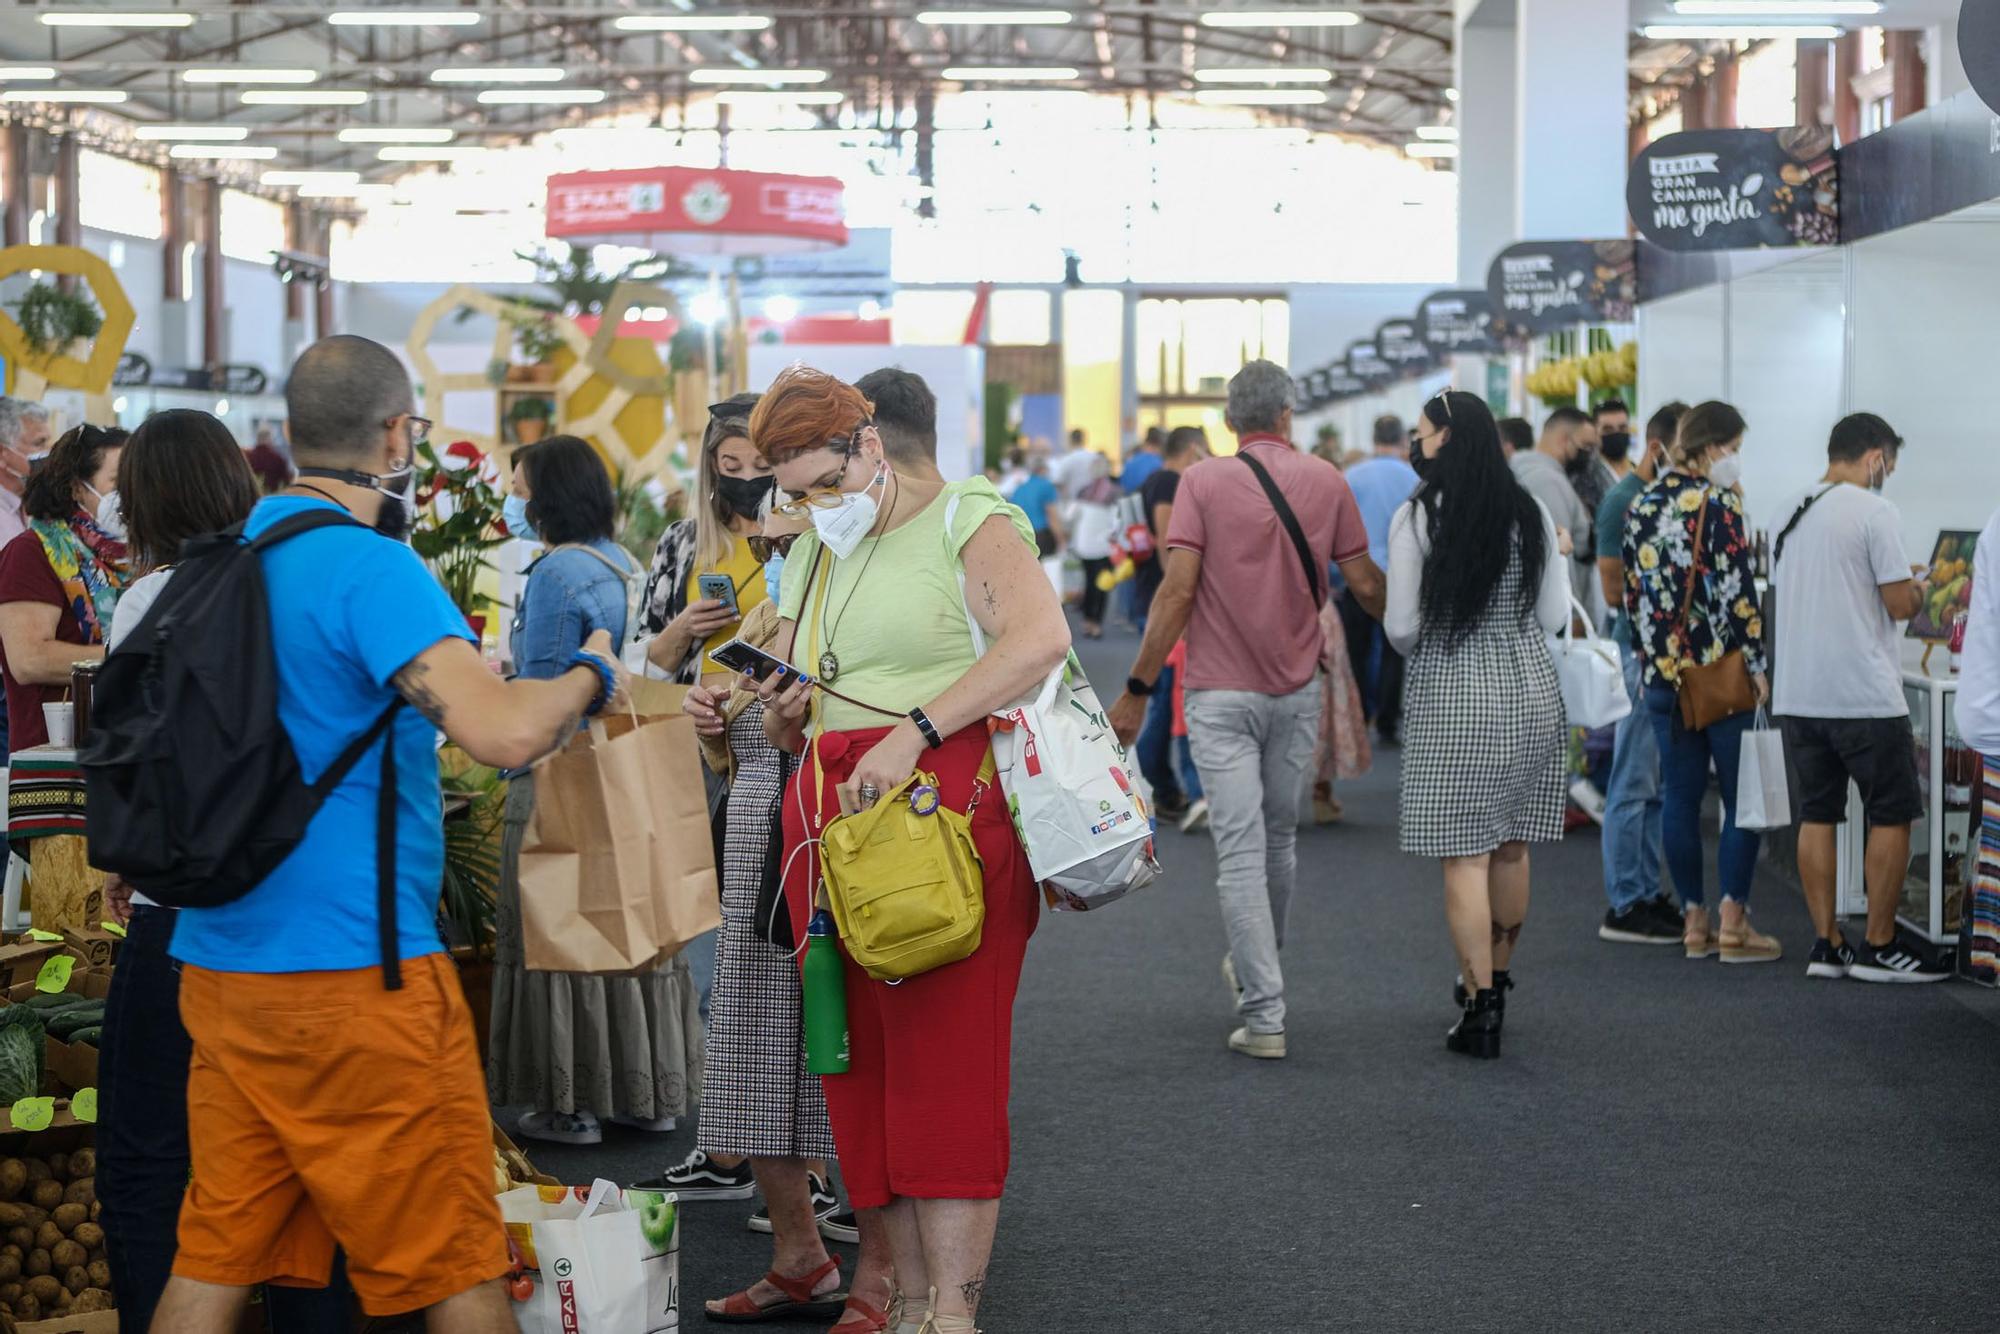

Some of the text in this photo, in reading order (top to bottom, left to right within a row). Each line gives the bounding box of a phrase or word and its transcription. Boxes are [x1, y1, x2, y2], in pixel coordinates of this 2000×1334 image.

[1655, 159, 1702, 175] FERIA
[1651, 174, 1696, 189] GRAN
[1651, 186, 1723, 203] CANARIA
[1653, 184, 1762, 237] me gusta
[560, 1281, 578, 1334] PAR
